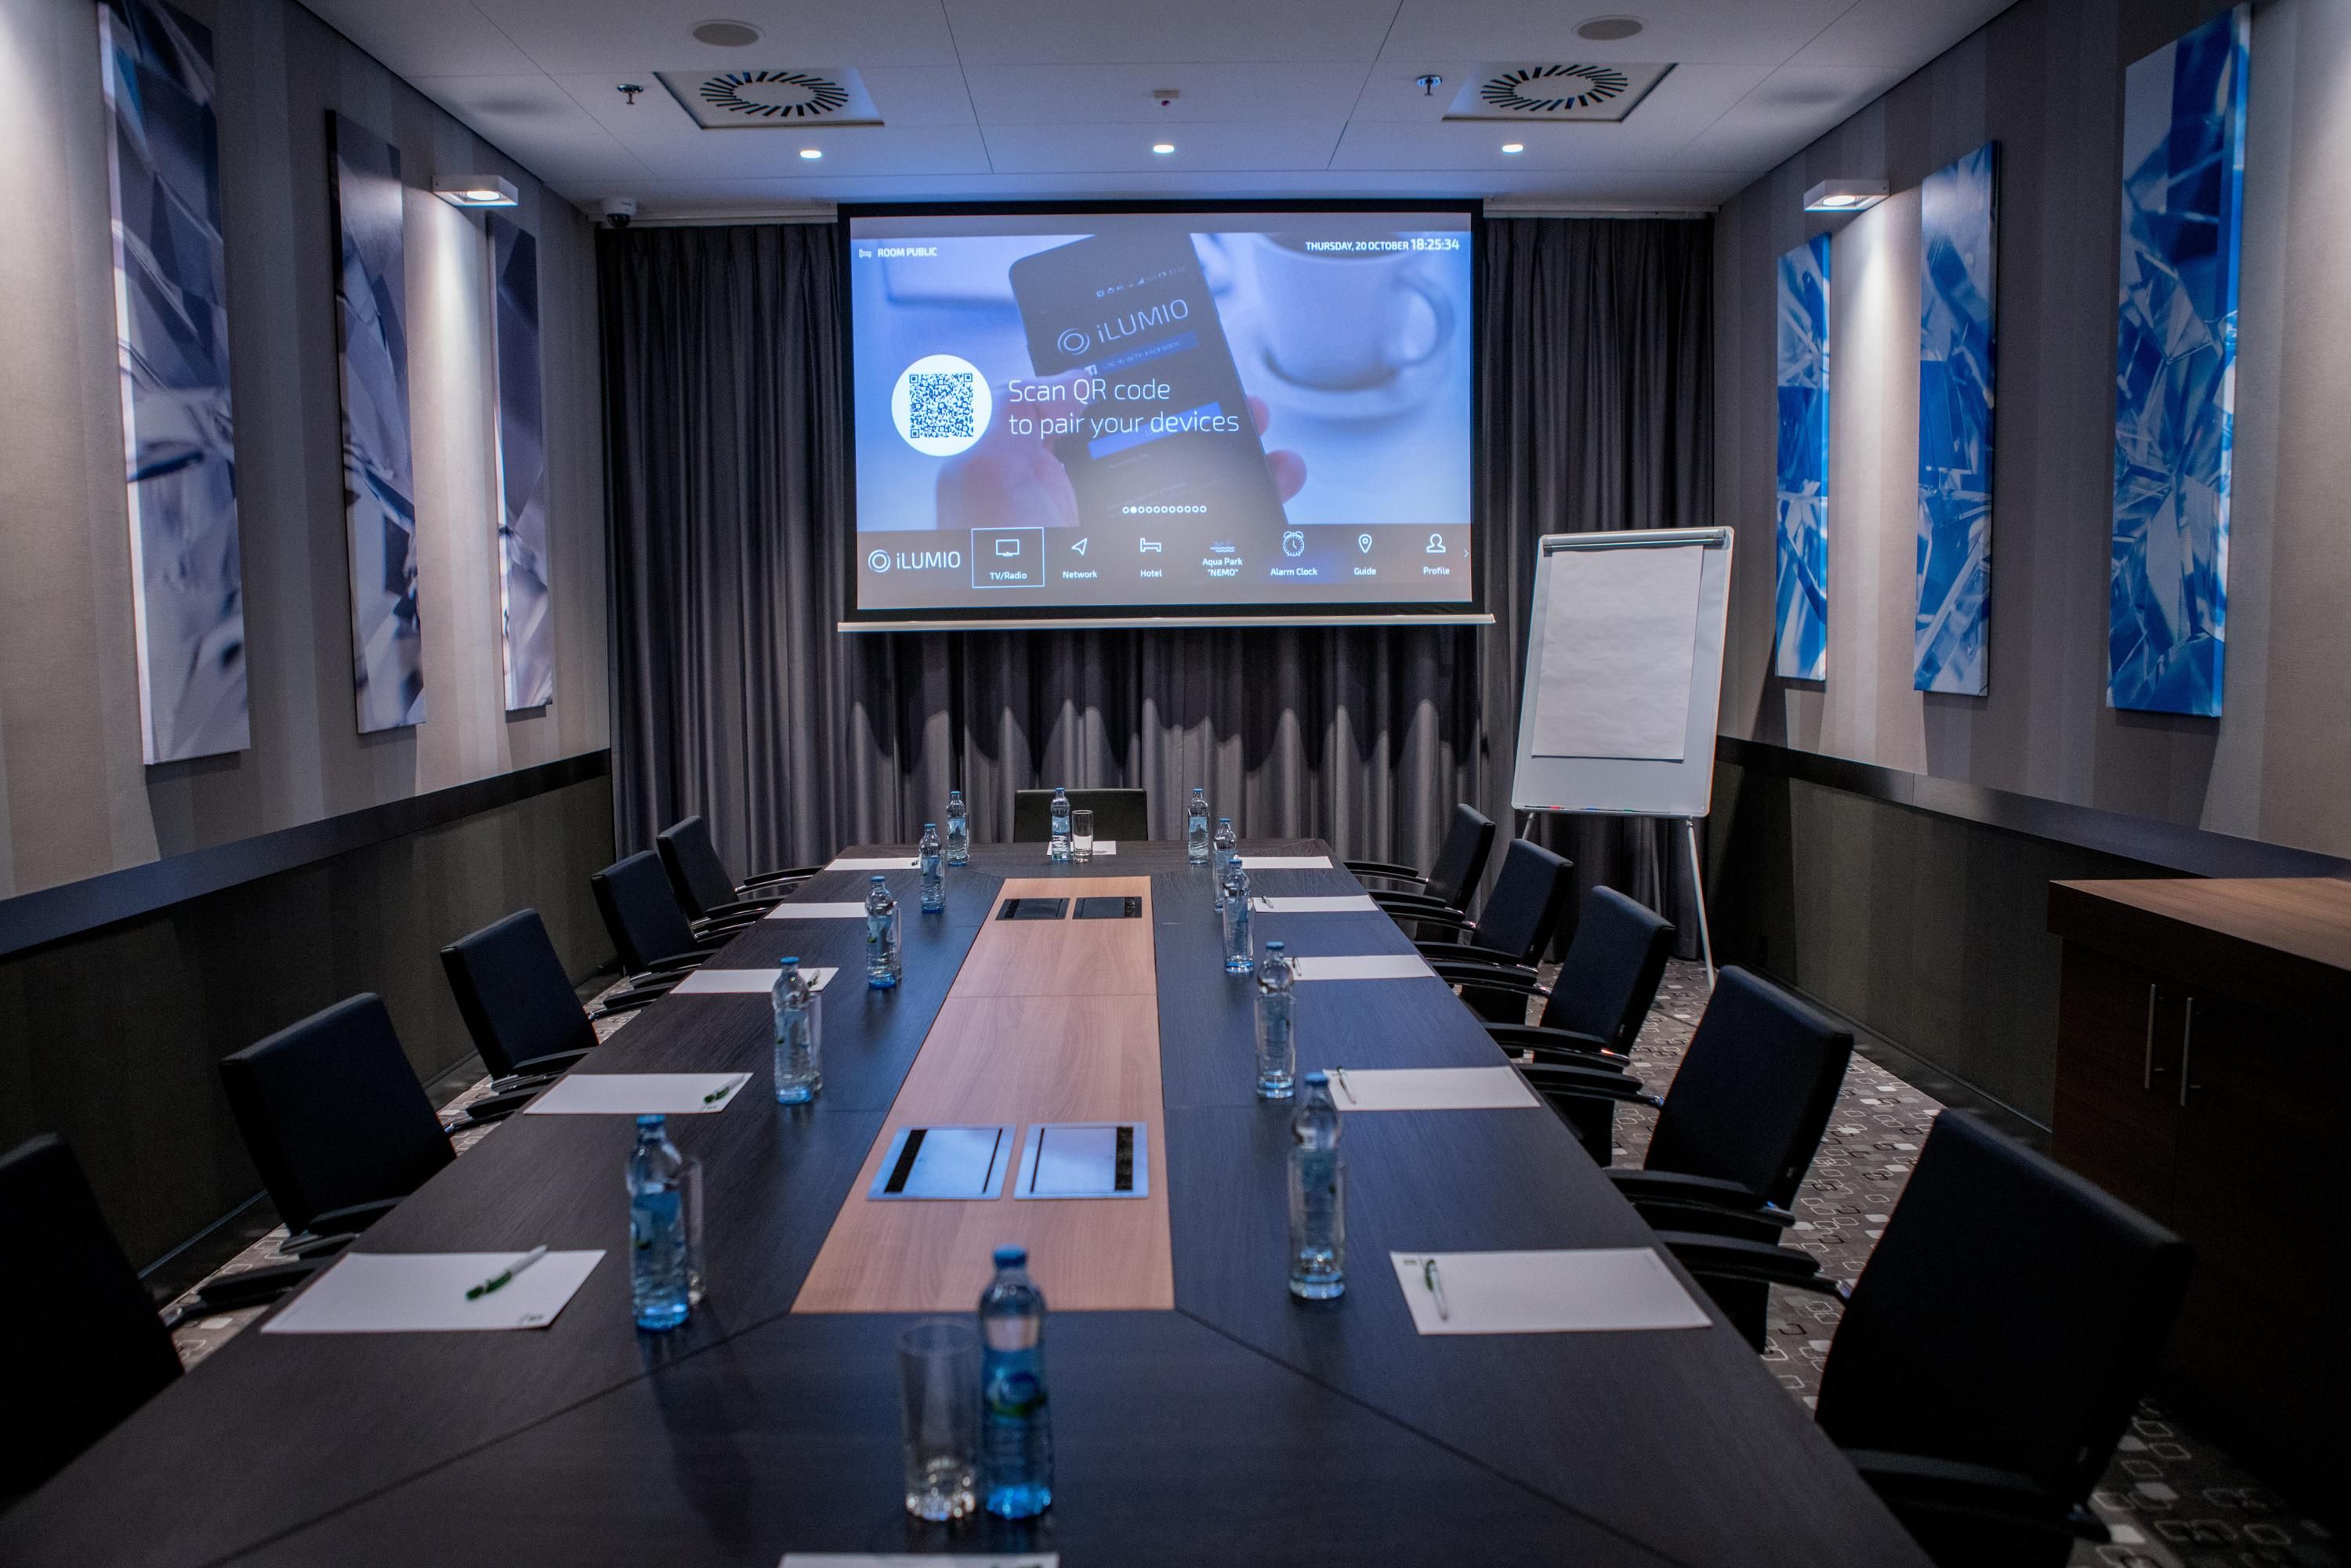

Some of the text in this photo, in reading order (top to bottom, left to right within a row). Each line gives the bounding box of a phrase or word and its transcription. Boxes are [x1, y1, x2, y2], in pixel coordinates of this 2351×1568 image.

[1306, 238, 1459, 251] THURSDAY, 20 OCTOBER 18:25:34
[878, 247, 937, 258] ROOM PUBLIC
[1096, 299, 1189, 343] iLUMIO
[1009, 378, 1171, 404] Scan QR code
[1009, 411, 1240, 439] to pair your devices
[896, 551, 961, 570] iLUMIO
[1202, 557, 1243, 567] Aqua Park
[989, 571, 1027, 581] TV/Radio
[1062, 570, 1098, 579] Network
[1140, 569, 1162, 578] Hotel
[1296, 567, 1318, 576] Clock
[1423, 567, 1450, 575] Profile
